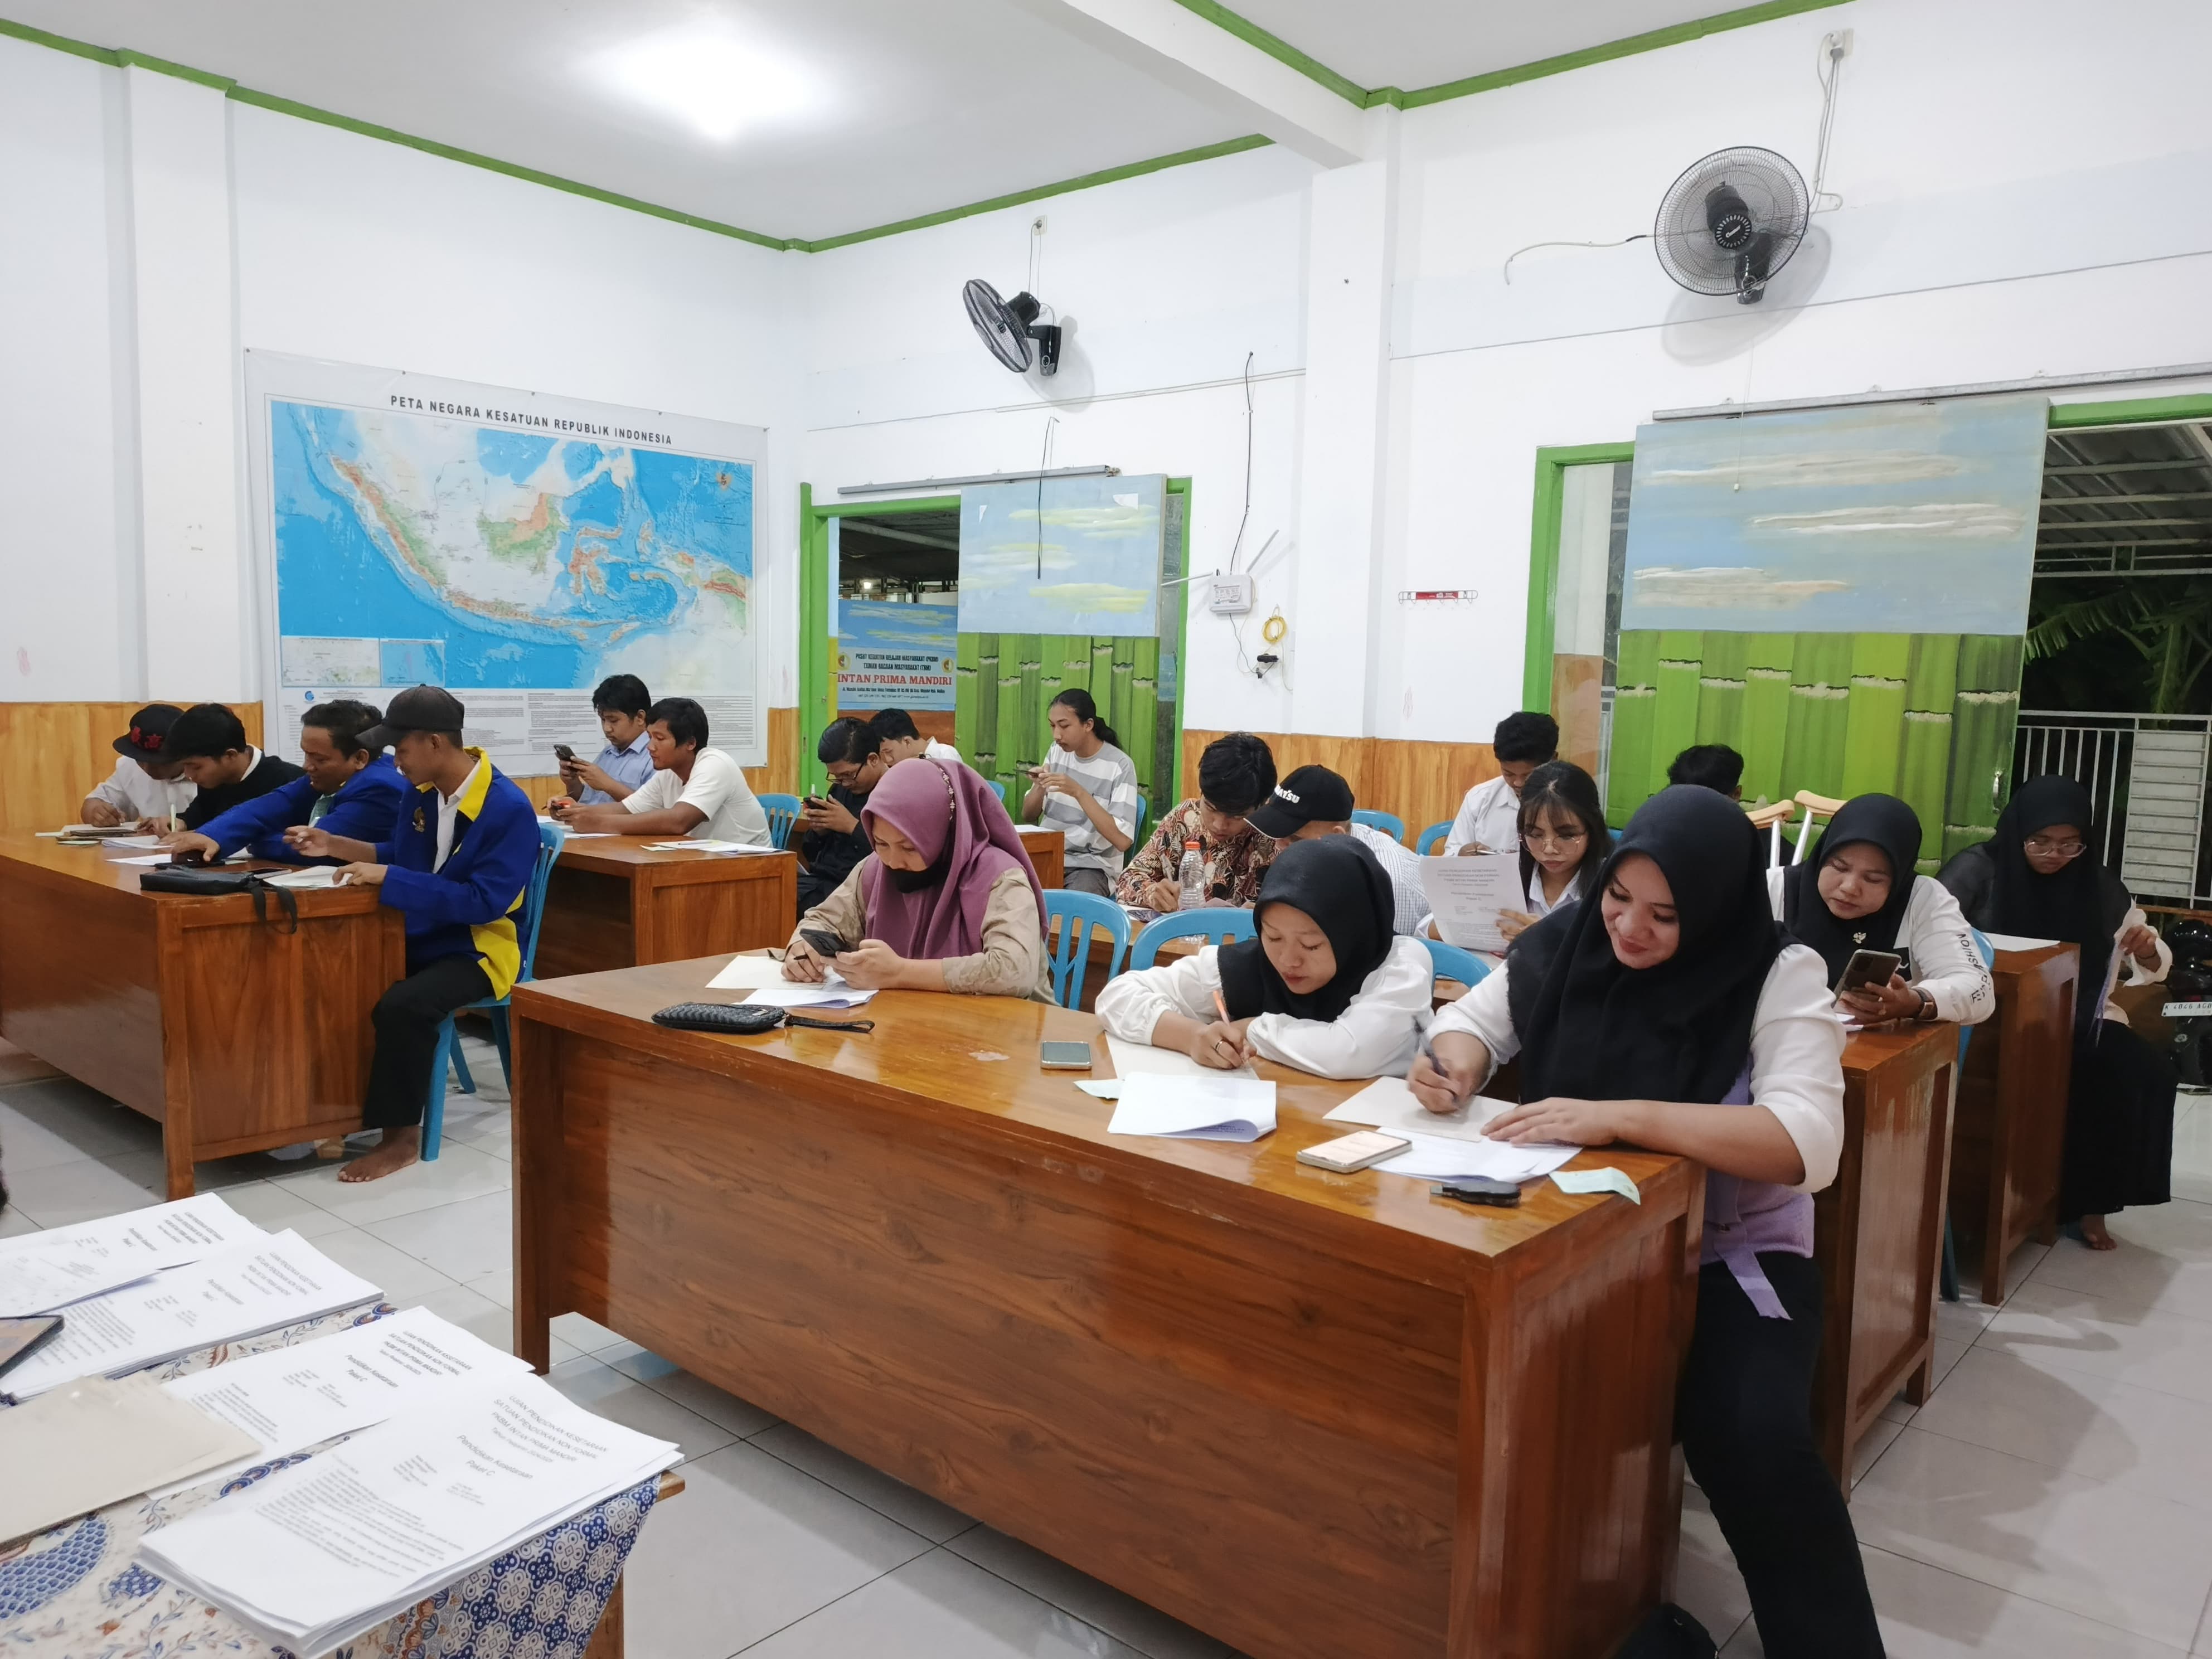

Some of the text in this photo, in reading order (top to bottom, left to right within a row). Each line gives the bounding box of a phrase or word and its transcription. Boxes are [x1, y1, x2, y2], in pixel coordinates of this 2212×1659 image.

[391, 395, 672, 444] PETA NEGARA KESATUAN REPUBLIK INDONESIA
[838, 673, 952, 685] INTAN PRIMA MANDIRI
